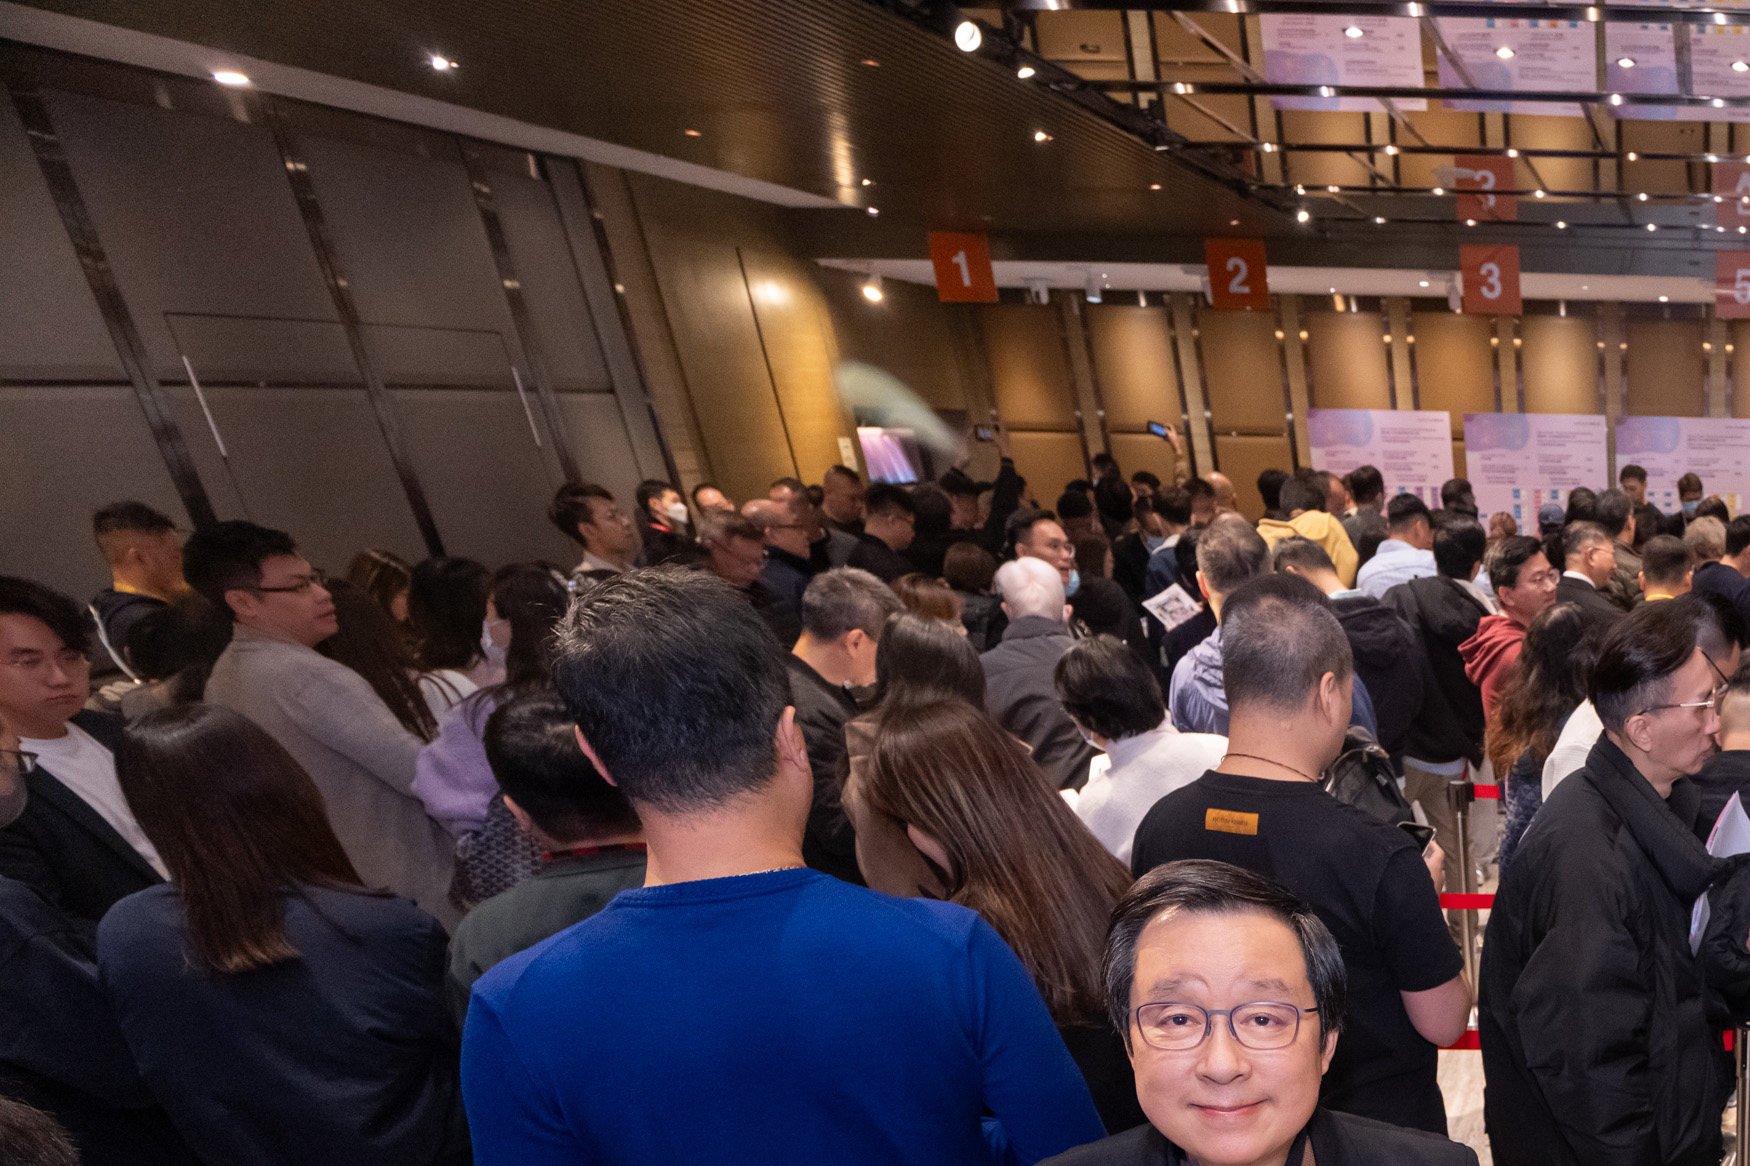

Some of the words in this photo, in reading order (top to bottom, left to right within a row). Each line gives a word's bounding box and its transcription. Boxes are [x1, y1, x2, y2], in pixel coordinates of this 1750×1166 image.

[951, 250, 972, 288] 1
[1225, 256, 1250, 294] 2
[1479, 262, 1502, 300] 3
